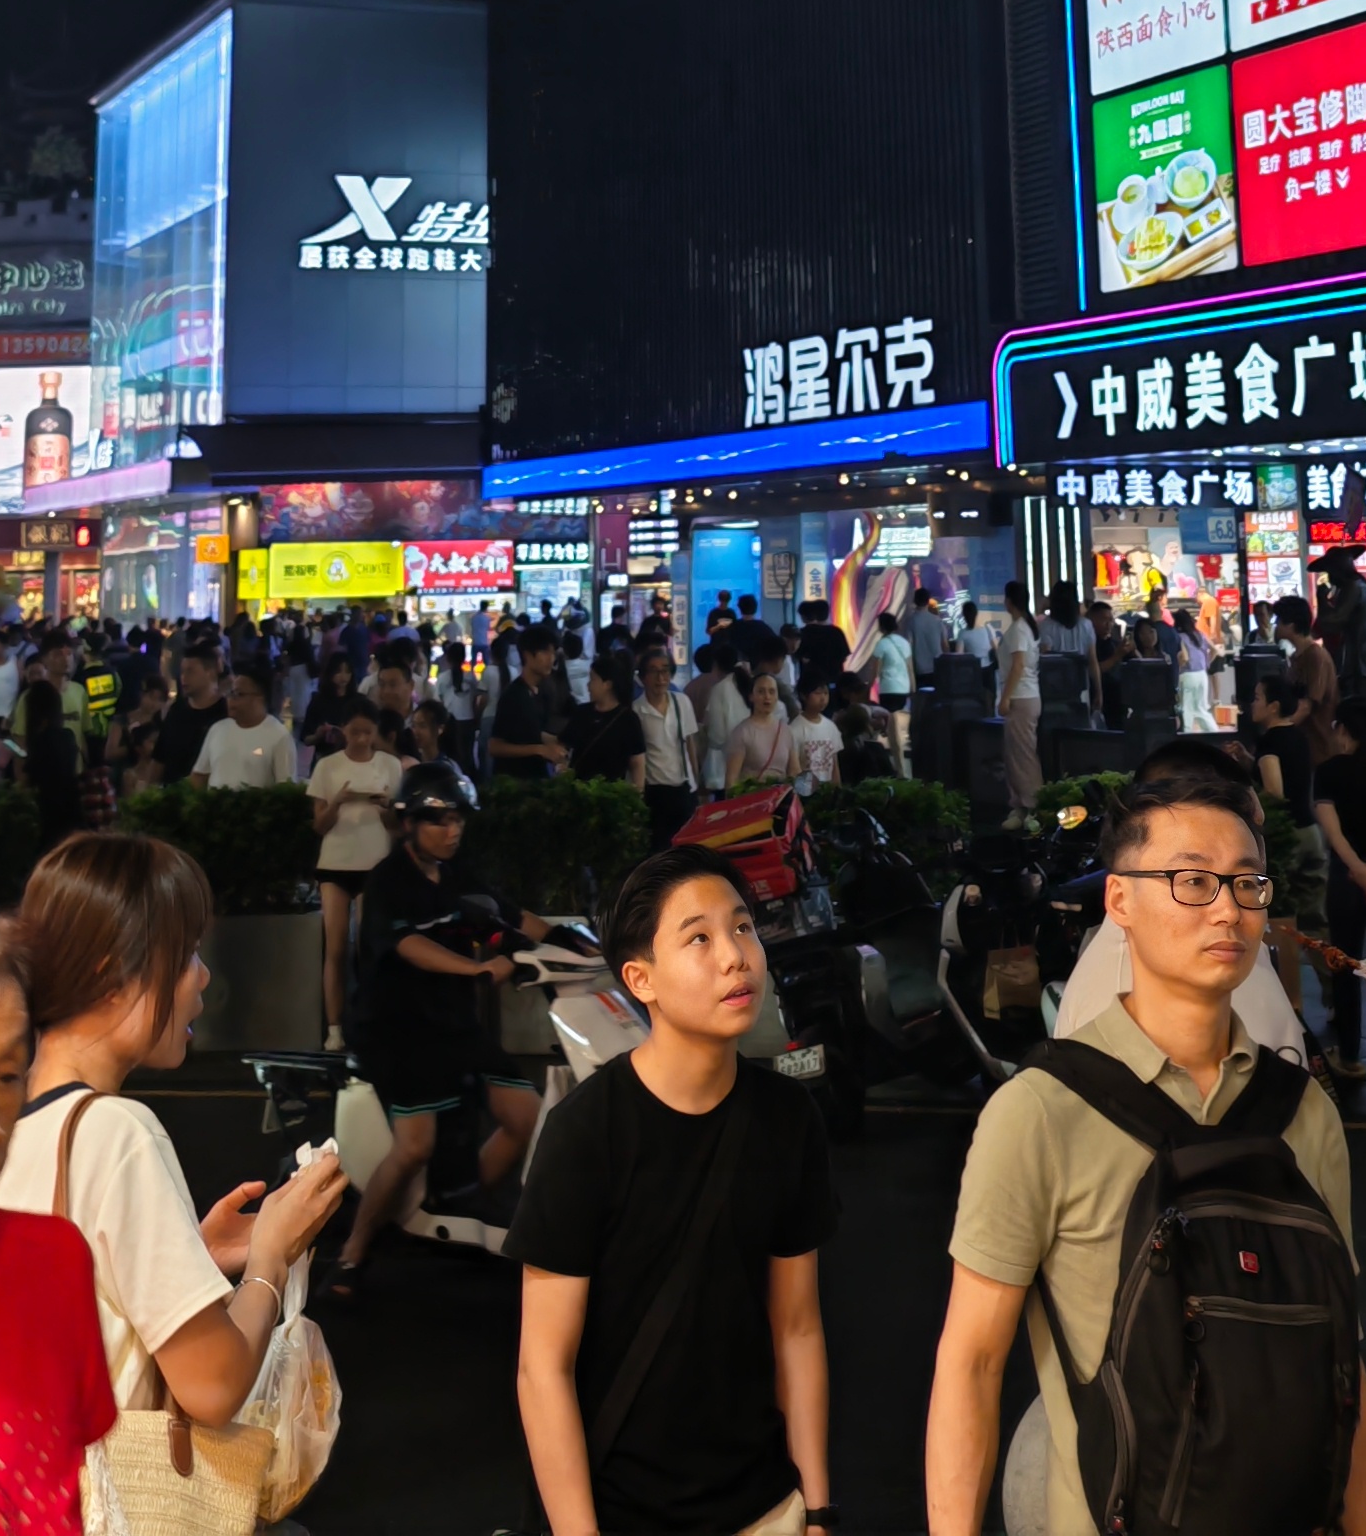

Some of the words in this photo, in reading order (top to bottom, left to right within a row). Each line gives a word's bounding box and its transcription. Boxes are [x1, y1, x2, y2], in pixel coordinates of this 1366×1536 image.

[742, 316, 936, 428] 鸿星尔克
[1056, 467, 1255, 506] 中威美食广场
